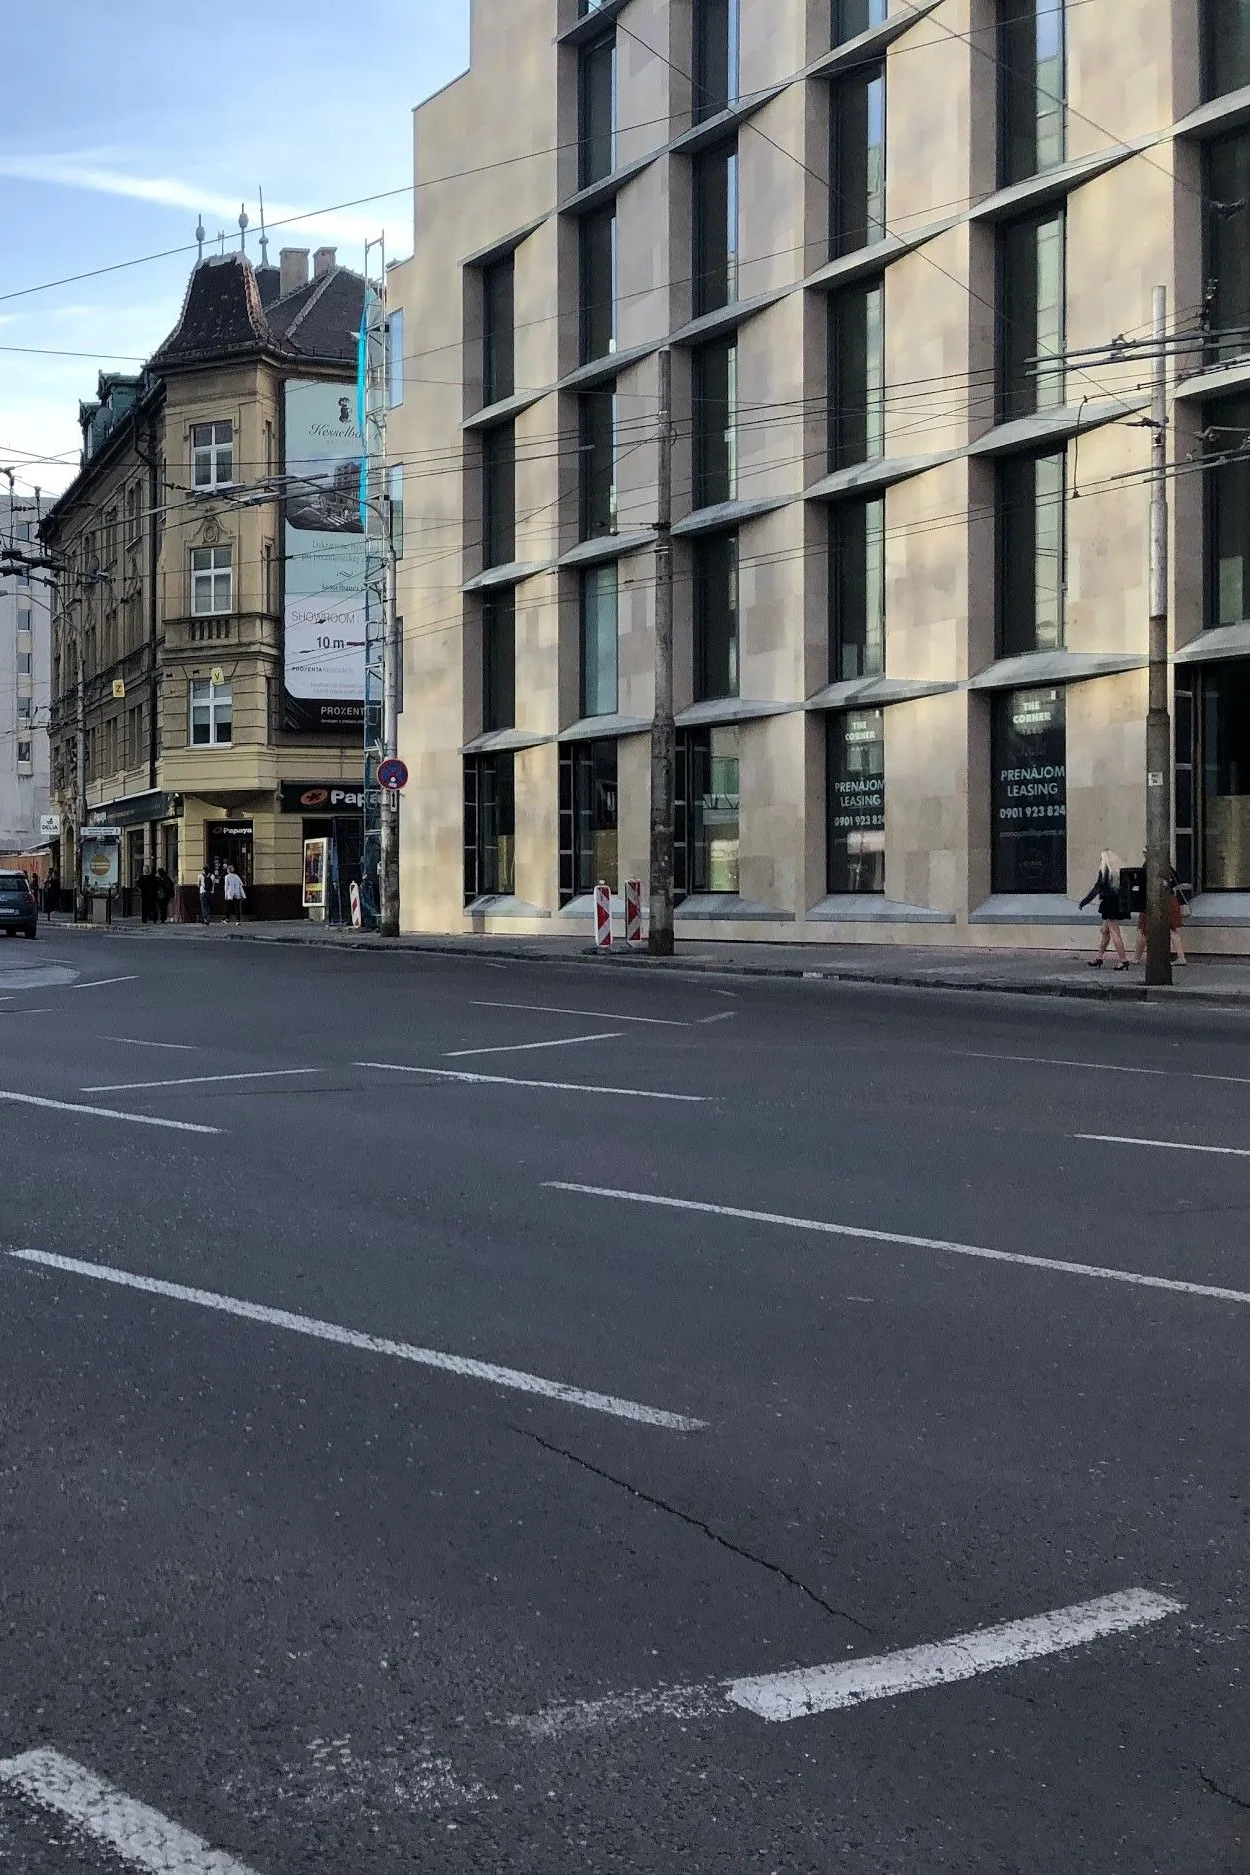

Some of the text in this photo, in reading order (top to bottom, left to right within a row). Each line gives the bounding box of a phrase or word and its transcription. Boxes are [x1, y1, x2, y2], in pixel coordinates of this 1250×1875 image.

[291, 611, 355, 624] SHOWROOM
[317, 636, 345, 648] 10 m
[214, 672, 220, 680] V
[116, 684, 121, 693] Z
[320, 706, 370, 717] PROXENT
[1023, 701, 1040, 711] THE
[1013, 712, 1051, 724] CORNER
[845, 730, 875, 741] CORNER
[1001, 764, 1065, 781] PRENÁJOM
[1007, 782, 1058, 797] LEASING
[840, 794, 881, 807] LEASING
[1000, 804, 1066, 819] 0901 923 824
[834, 816, 854, 827] 0901
[855, 815, 871, 826] 923
[223, 826, 252, 834] Papaya
